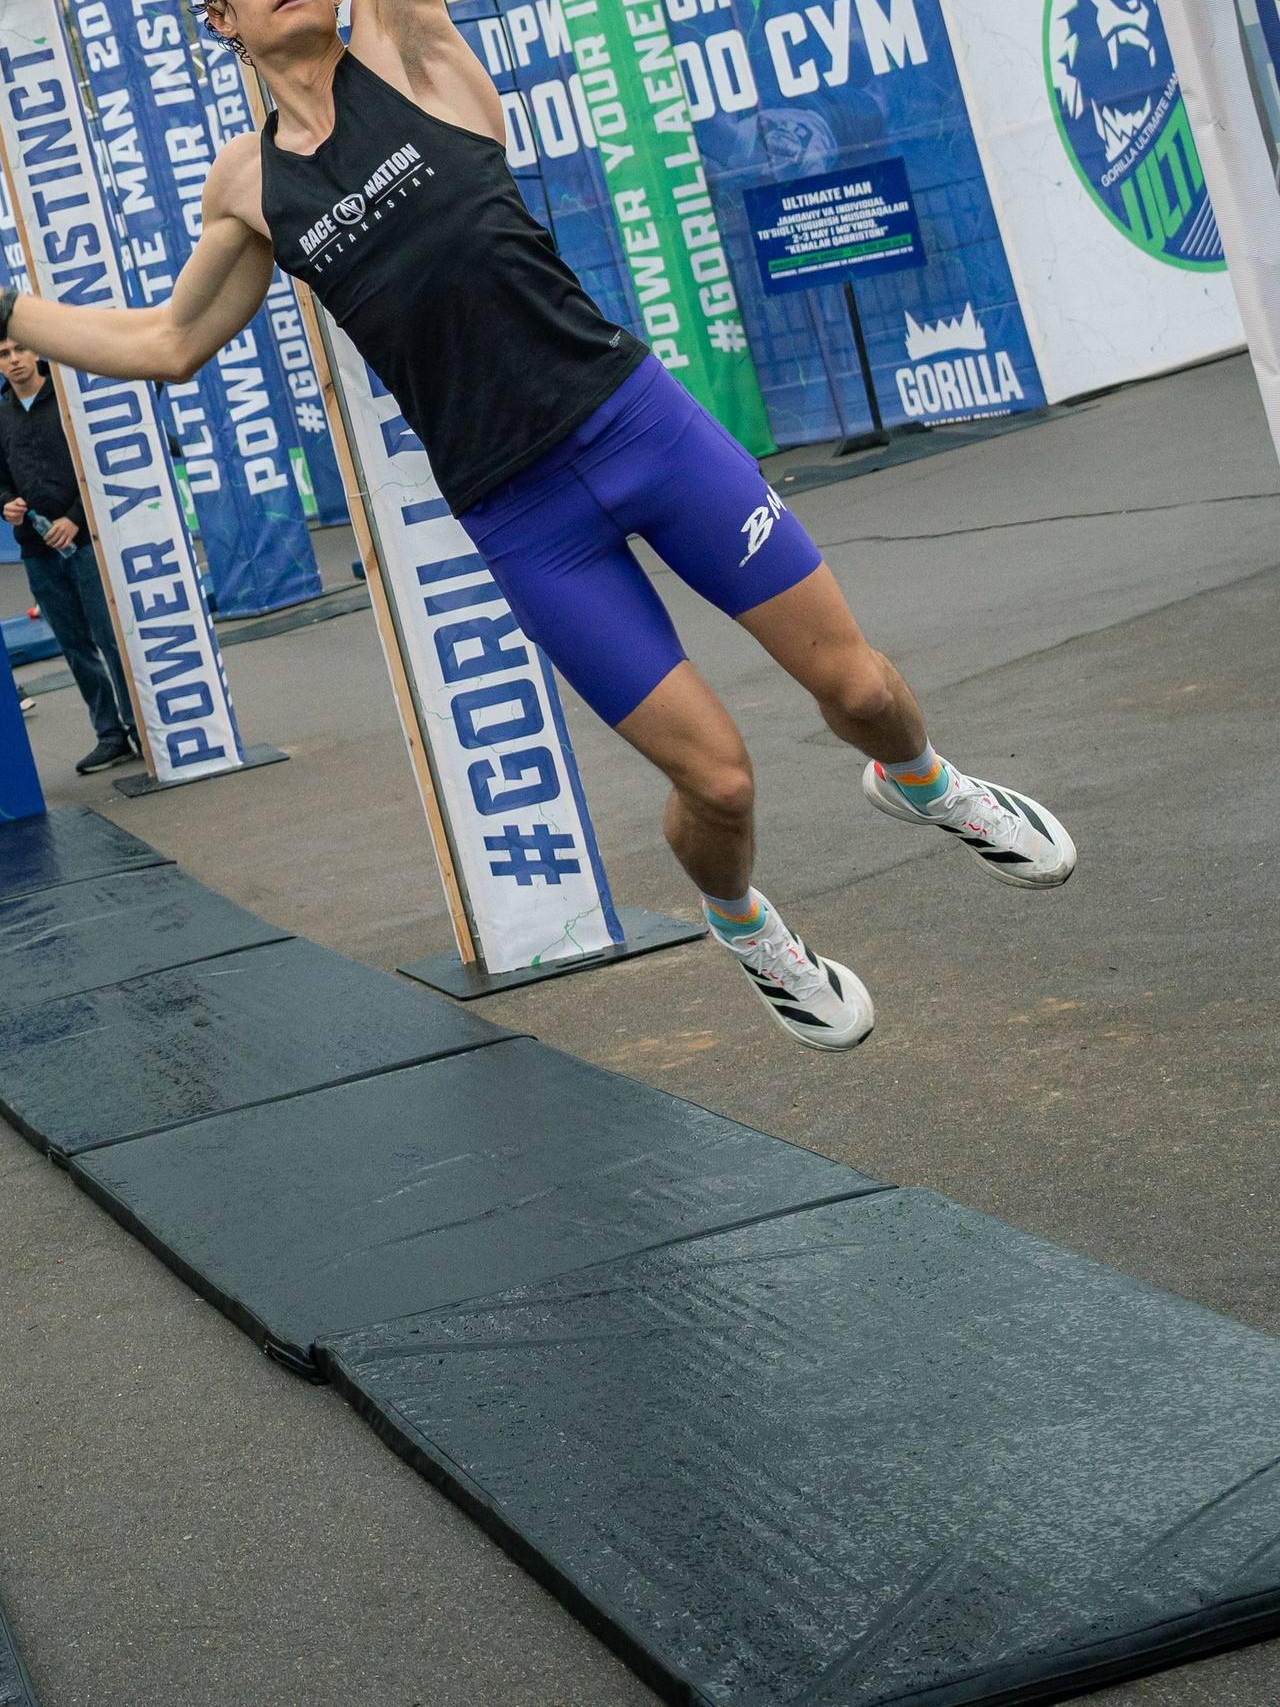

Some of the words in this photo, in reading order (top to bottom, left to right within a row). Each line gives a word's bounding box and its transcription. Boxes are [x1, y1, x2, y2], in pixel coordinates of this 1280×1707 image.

[97, 88, 156, 216] MAN
[574, 32, 635, 173] YOUR
[1101, 147, 1138, 188] GORILLA
[1135, 97, 1170, 151] ULTIMATE
[299, 213, 337, 256] RACE
[363, 142, 421, 199] NATION
[314, 167, 435, 273] KAZAKHSTAN
[782, 187, 842, 211] ULTIMATE
[843, 181, 872, 198] MAN
[793, 231, 809, 244] 2-3
[810, 228, 829, 242] MAY
[822, 206, 835, 217] VA
[835, 196, 885, 215] INDIVIDUAL
[617, 187, 690, 370] POWER
[217, 328, 289, 496] POWE
[895, 350, 1025, 418] GORILLA
[122, 537, 226, 770] POWER
